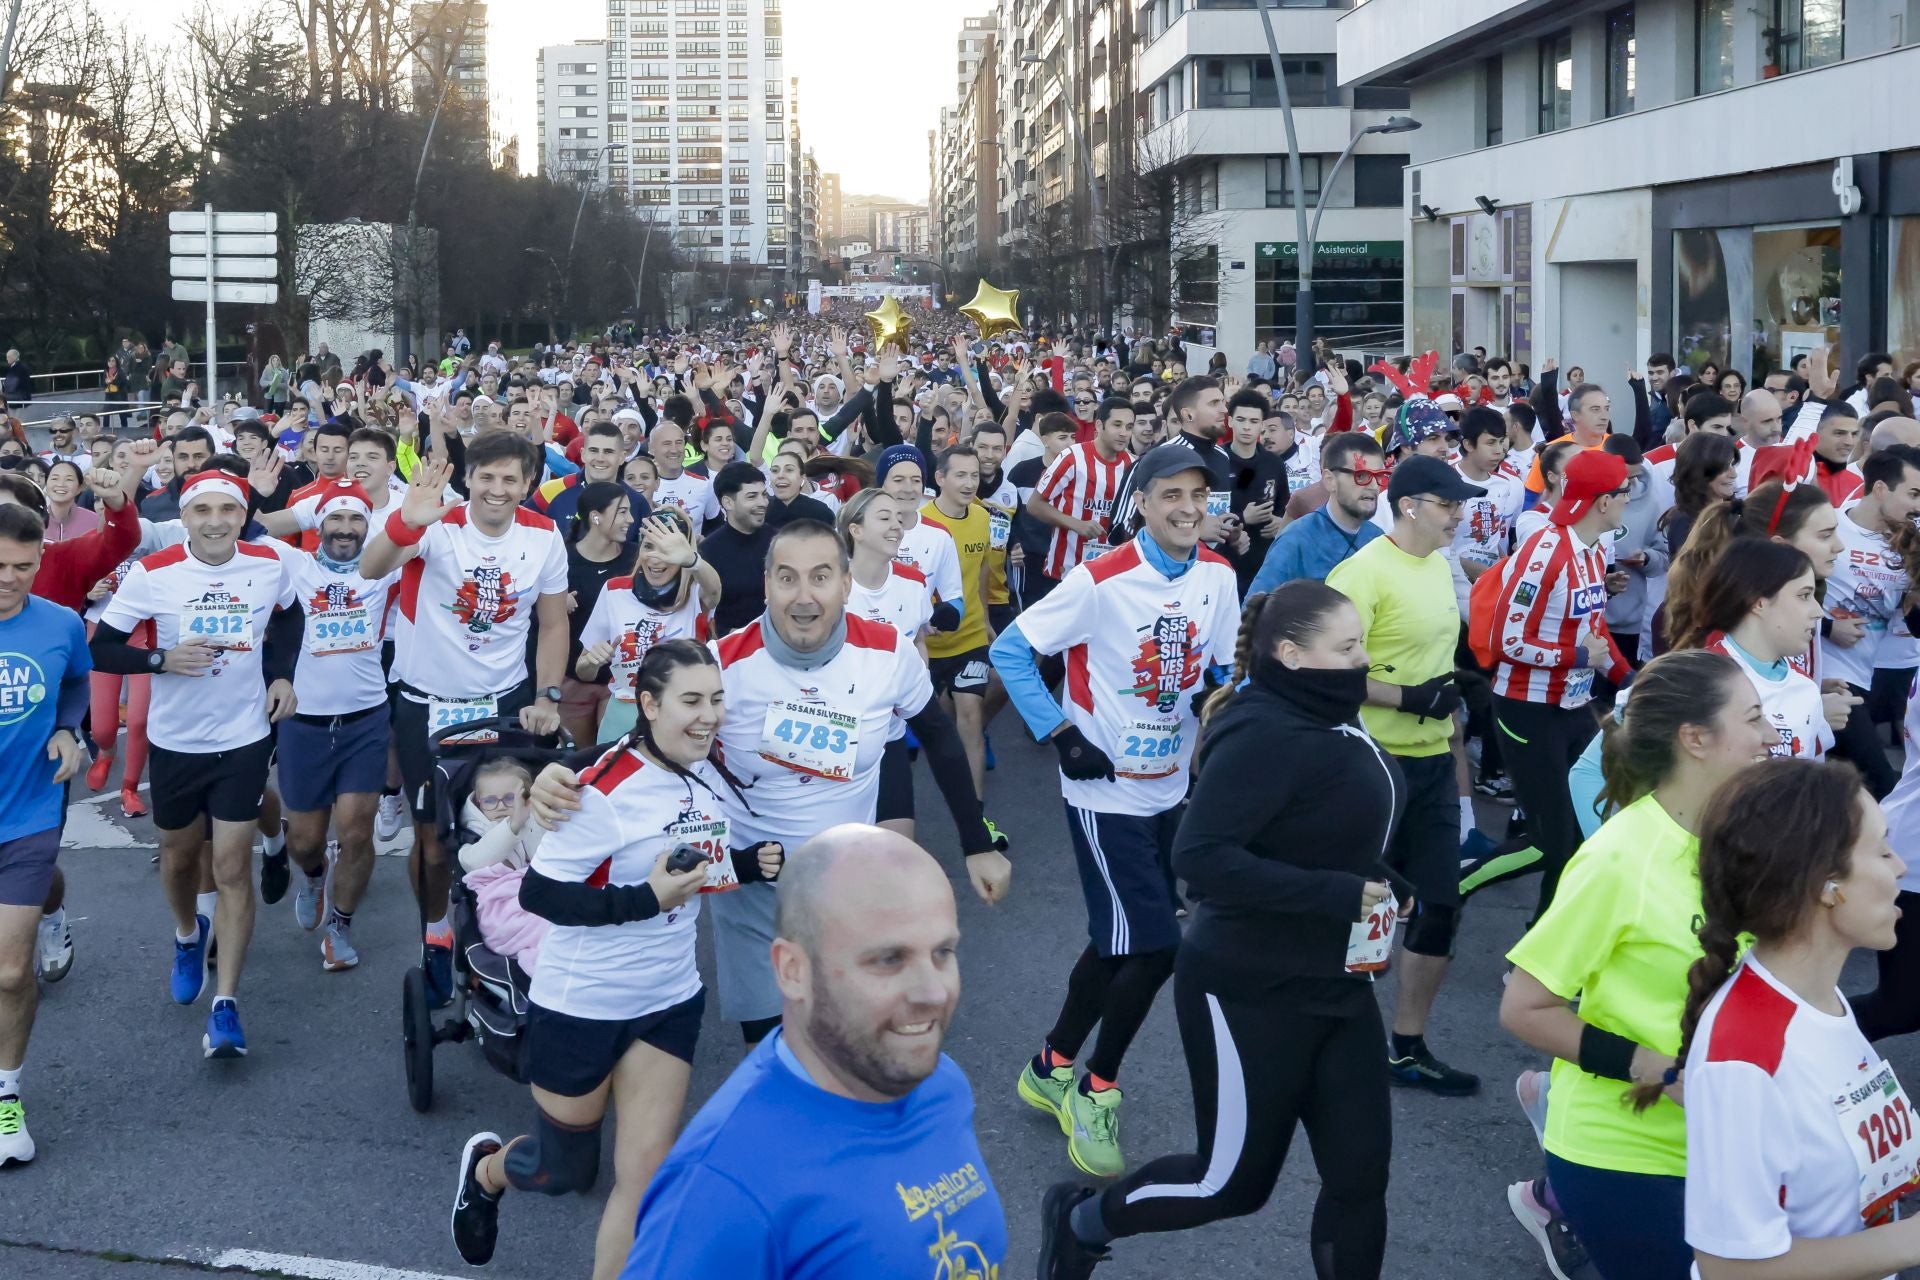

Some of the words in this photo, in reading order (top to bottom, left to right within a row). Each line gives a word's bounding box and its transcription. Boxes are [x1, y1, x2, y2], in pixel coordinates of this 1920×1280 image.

[1318, 243, 1368, 254] Asistencial
[965, 543, 985, 553] NASA
[1850, 550, 1880, 566] 52
[477, 575, 500, 589] SAN
[485, 569, 500, 579] 55
[215, 593, 230, 602] 55
[336, 586, 349, 594] 55
[478, 588, 500, 600] SIL
[477, 598, 500, 611] VES
[340, 609, 366, 617] SILVESTRE
[473, 609, 497, 623] TRE
[190, 616, 243, 634] 4312
[316, 620, 366, 638] 3964
[1170, 617, 1188, 632] 55
[1160, 627, 1187, 643] SAN
[1160, 643, 1185, 660] SIL
[1160, 658, 1185, 675] VES
[1157, 674, 1182, 693] TRE
[1, 685, 28, 706] ET
[437, 707, 489, 726] 2372
[786, 703, 798, 711] 55
[798, 705, 816, 715] SAN
[816, 708, 857, 725] SILVESTRE
[774, 719, 848, 753] 4783
[1780, 730, 1792, 743] 55
[1125, 734, 1183, 757] 2280
[681, 826, 689, 834] 55
[689, 824, 702, 833] SAN
[702, 821, 726, 832] SILVESTRE
[689, 838, 724, 864] 26
[1850, 1092, 1861, 1105] 55
[1859, 1084, 1873, 1100] SAN
[1870, 1067, 1893, 1092] SILVESTRE
[1858, 1096, 1912, 1164] 1207
